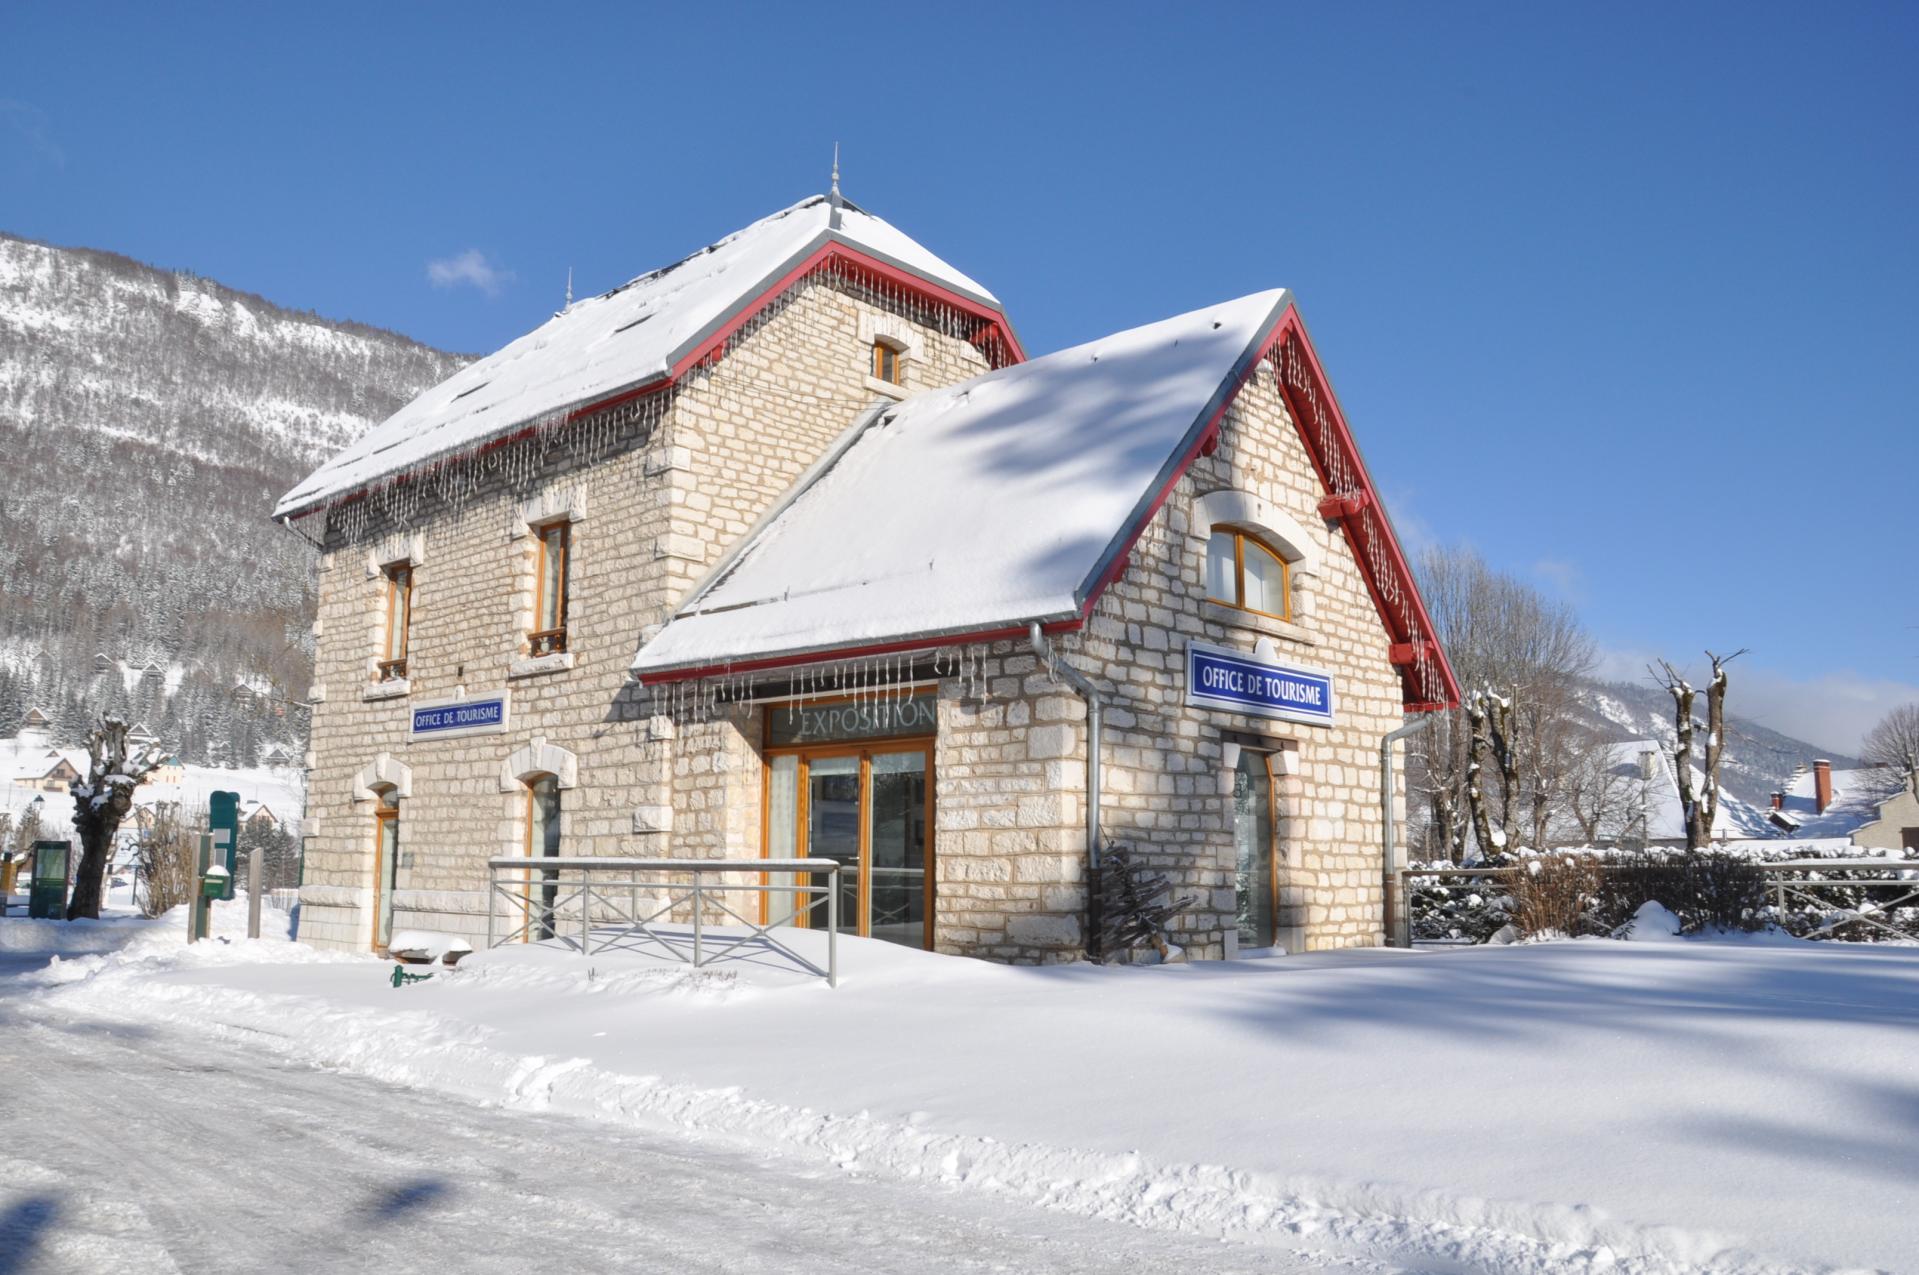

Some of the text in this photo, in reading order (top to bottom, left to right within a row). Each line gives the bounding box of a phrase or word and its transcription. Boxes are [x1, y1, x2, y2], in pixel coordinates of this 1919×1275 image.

[1203, 666, 1321, 705] OFFICE DE TOURISME
[416, 706, 499, 727] OFFICE DE TOURISME
[801, 701, 936, 735] EXPOSITION
